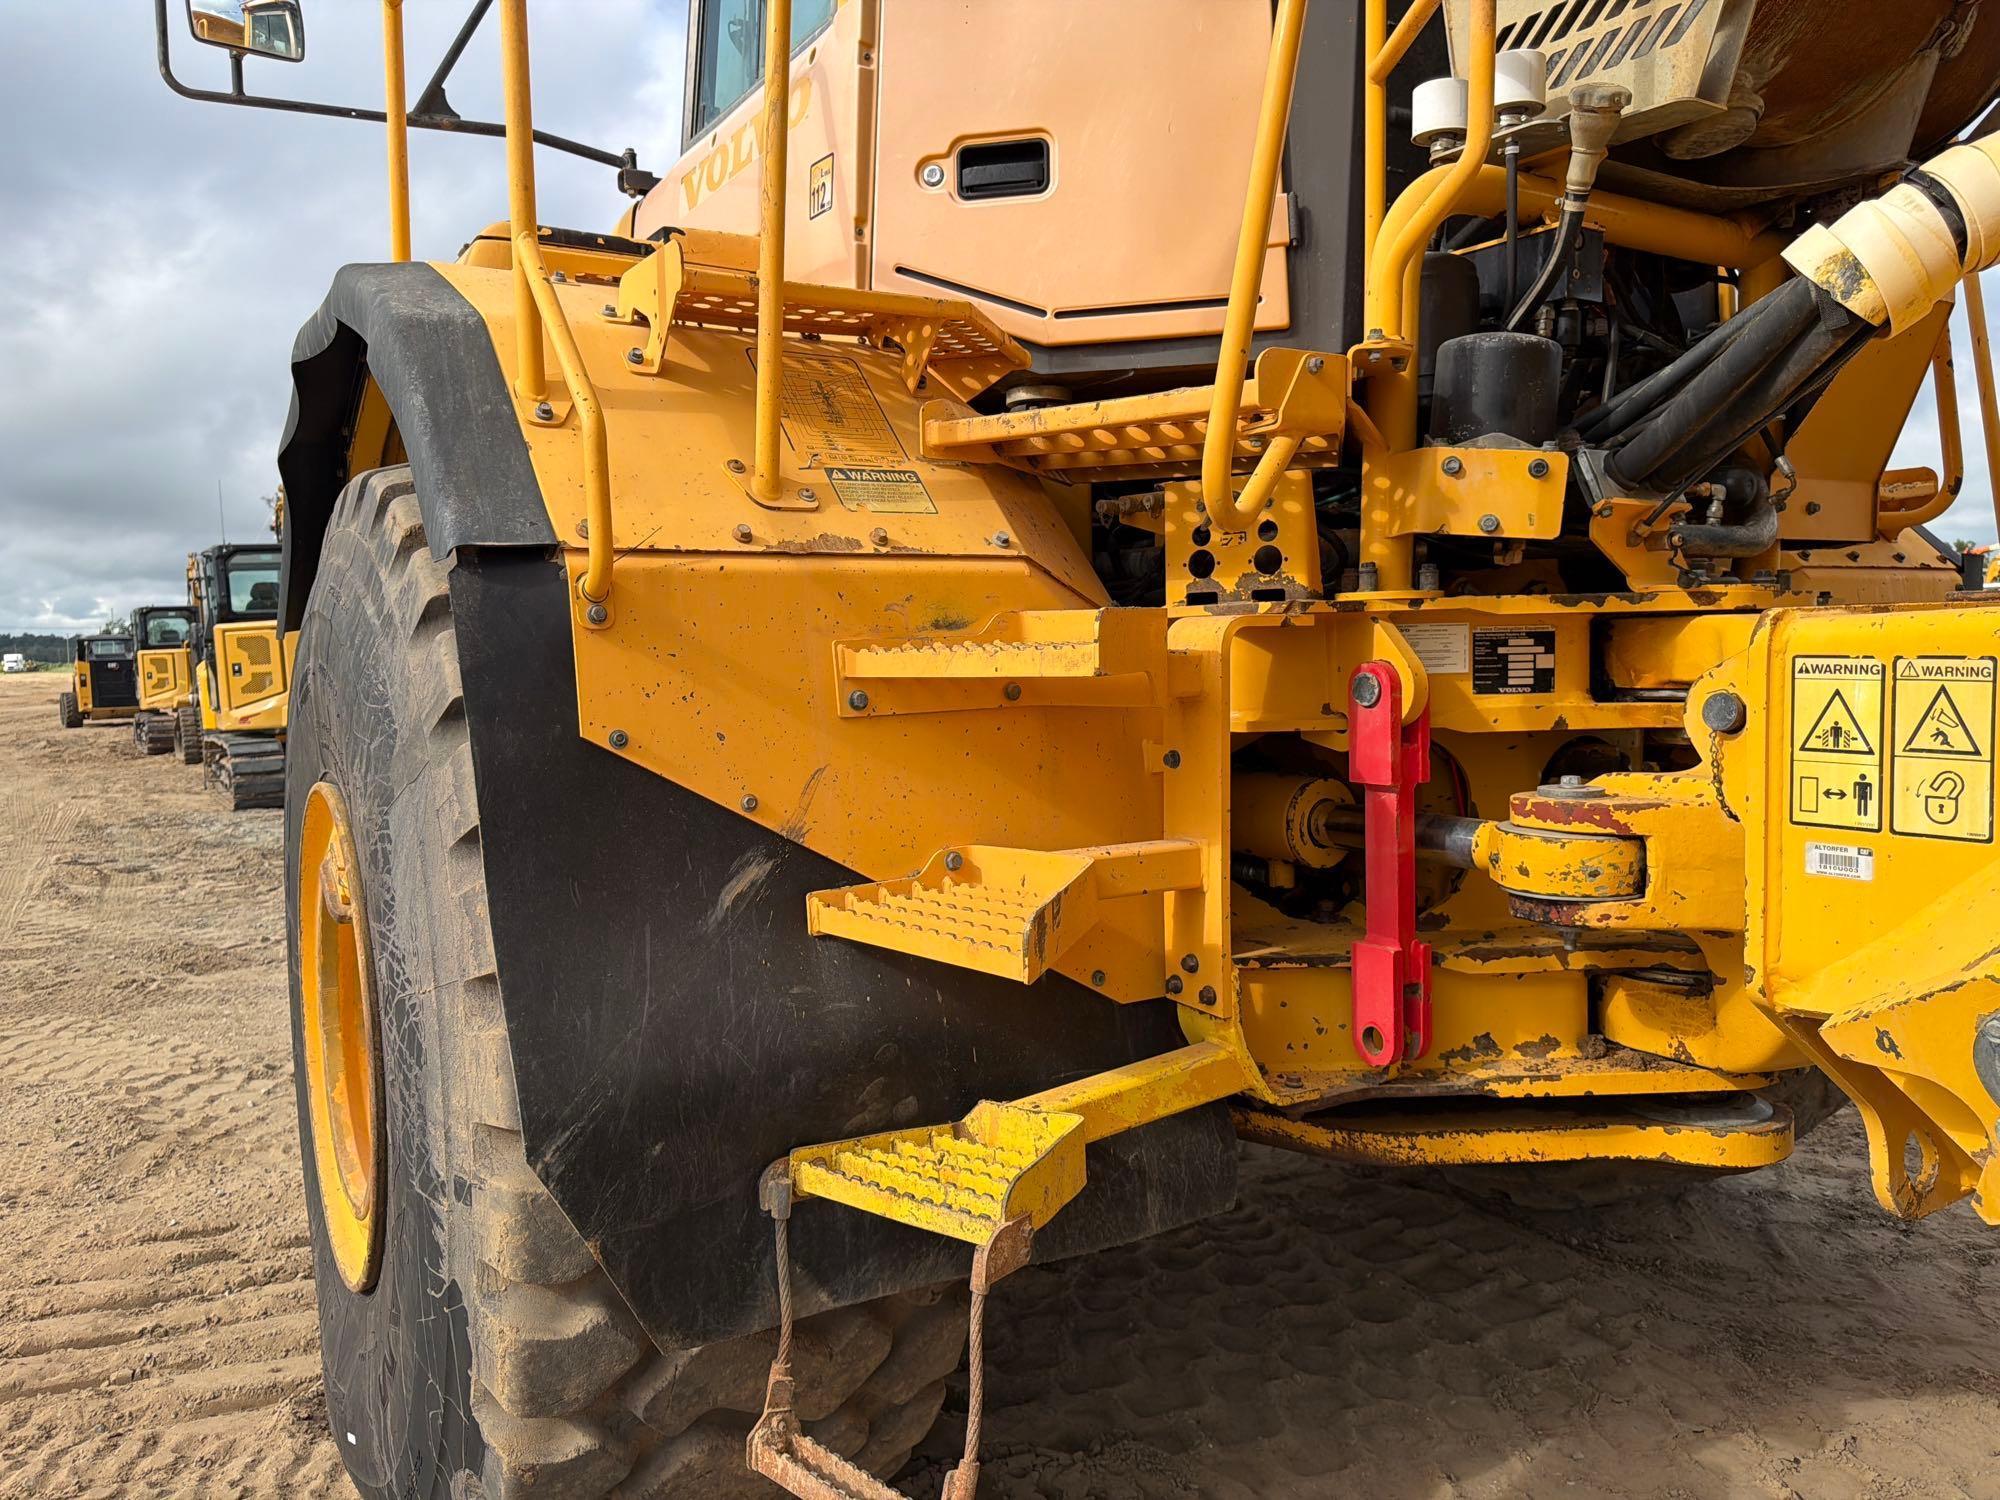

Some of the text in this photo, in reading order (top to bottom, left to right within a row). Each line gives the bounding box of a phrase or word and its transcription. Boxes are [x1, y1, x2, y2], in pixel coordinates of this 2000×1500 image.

[812, 181, 826, 214] 112
[847, 470, 918, 482] WARNING
[1810, 663, 1881, 677] WARNING
[1922, 665, 1992, 679] WARNING
[1814, 844, 1849, 854] ALTORFER
